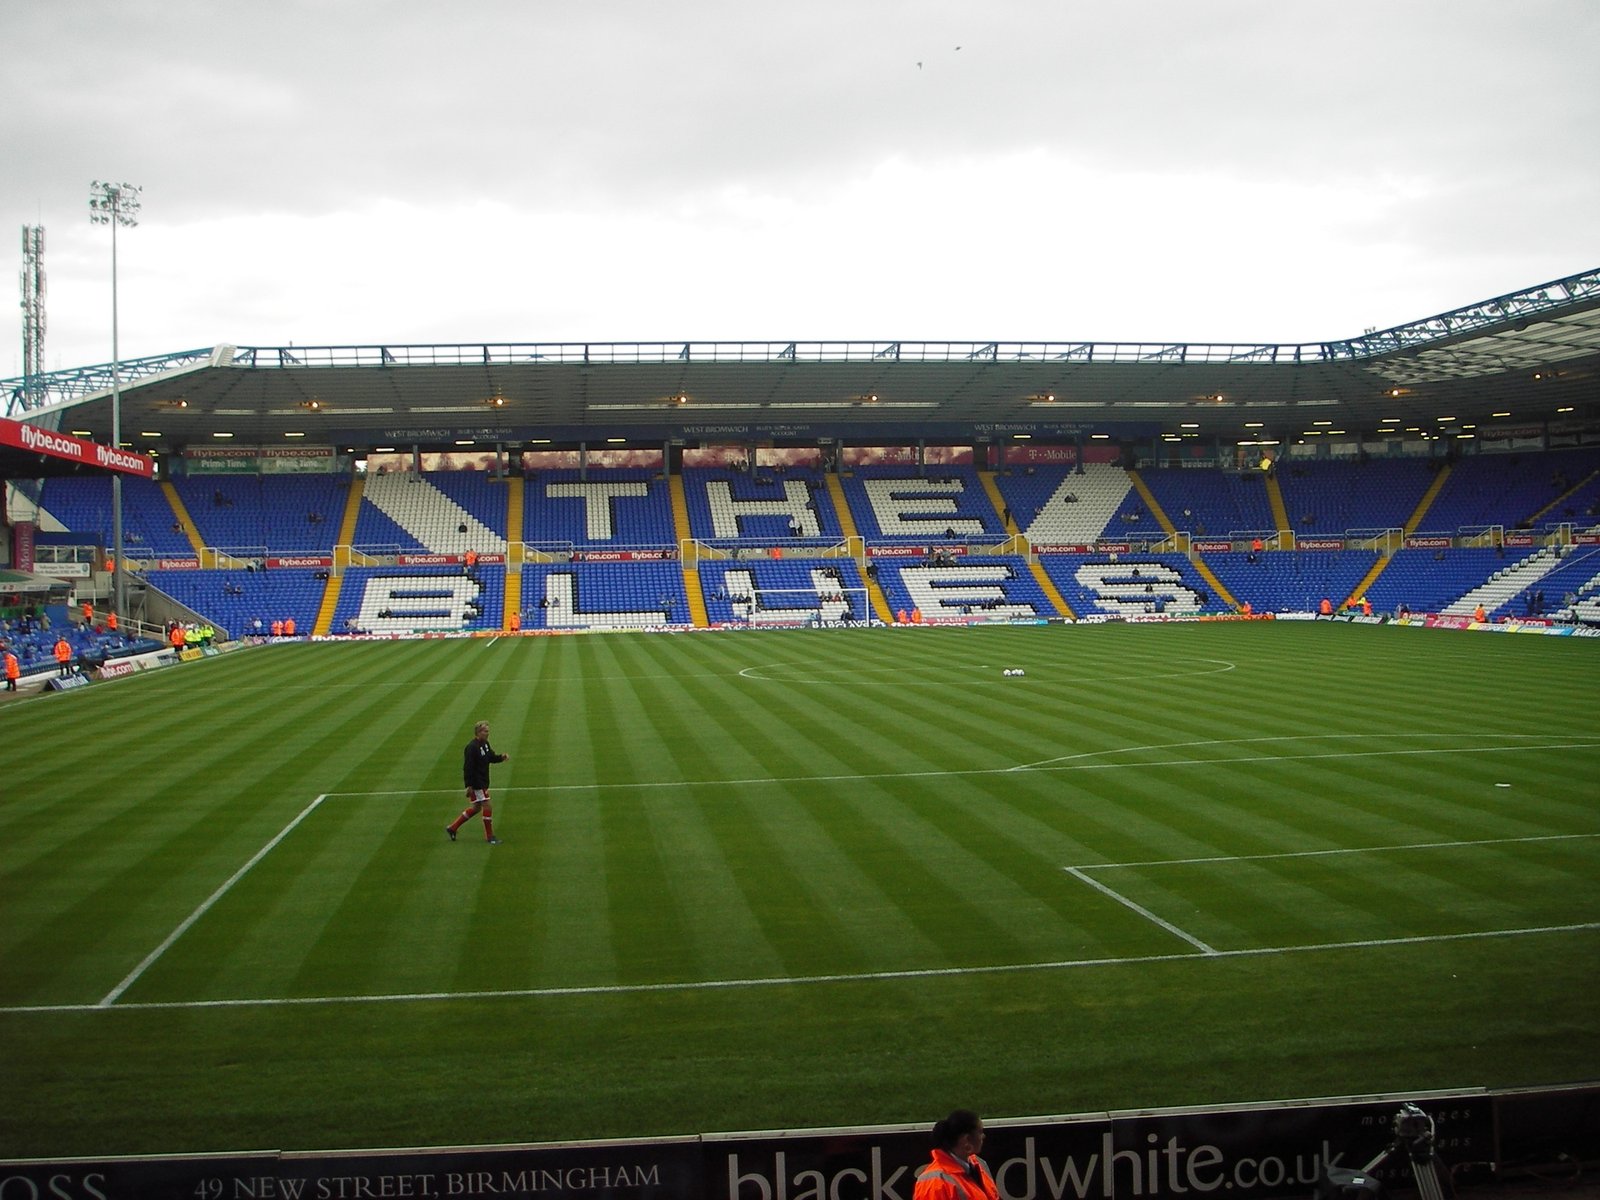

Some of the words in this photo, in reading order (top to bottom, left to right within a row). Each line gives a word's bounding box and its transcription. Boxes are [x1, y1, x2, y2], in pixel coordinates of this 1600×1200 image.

[21, 424, 82, 458] flybe.com
[193, 449, 256, 458] flybe.com
[266, 449, 329, 457] flybe.com
[96, 445, 144, 471] flybe.com
[546, 478, 986, 540] THE
[1300, 540, 1340, 549] flybe.com
[1409, 538, 1447, 547] flybe.com
[872, 547, 913, 556] flybe.com
[1037, 545, 1076, 553] flybe.com
[1197, 543, 1229, 552] flybe.com
[278, 558, 321, 567] flybe.com
[405, 555, 447, 564] flybe.com
[161, 560, 198, 570] flybe.com
[358, 563, 1202, 633] BLUES
[728, 1132, 1344, 1200] blackdwhite.co.uk
[193, 1178, 223, 1200] 49
[234, 1176, 307, 1200] NEW
[317, 1174, 439, 1200] STREET,
[446, 1164, 661, 1196] BIRMINGHAM
